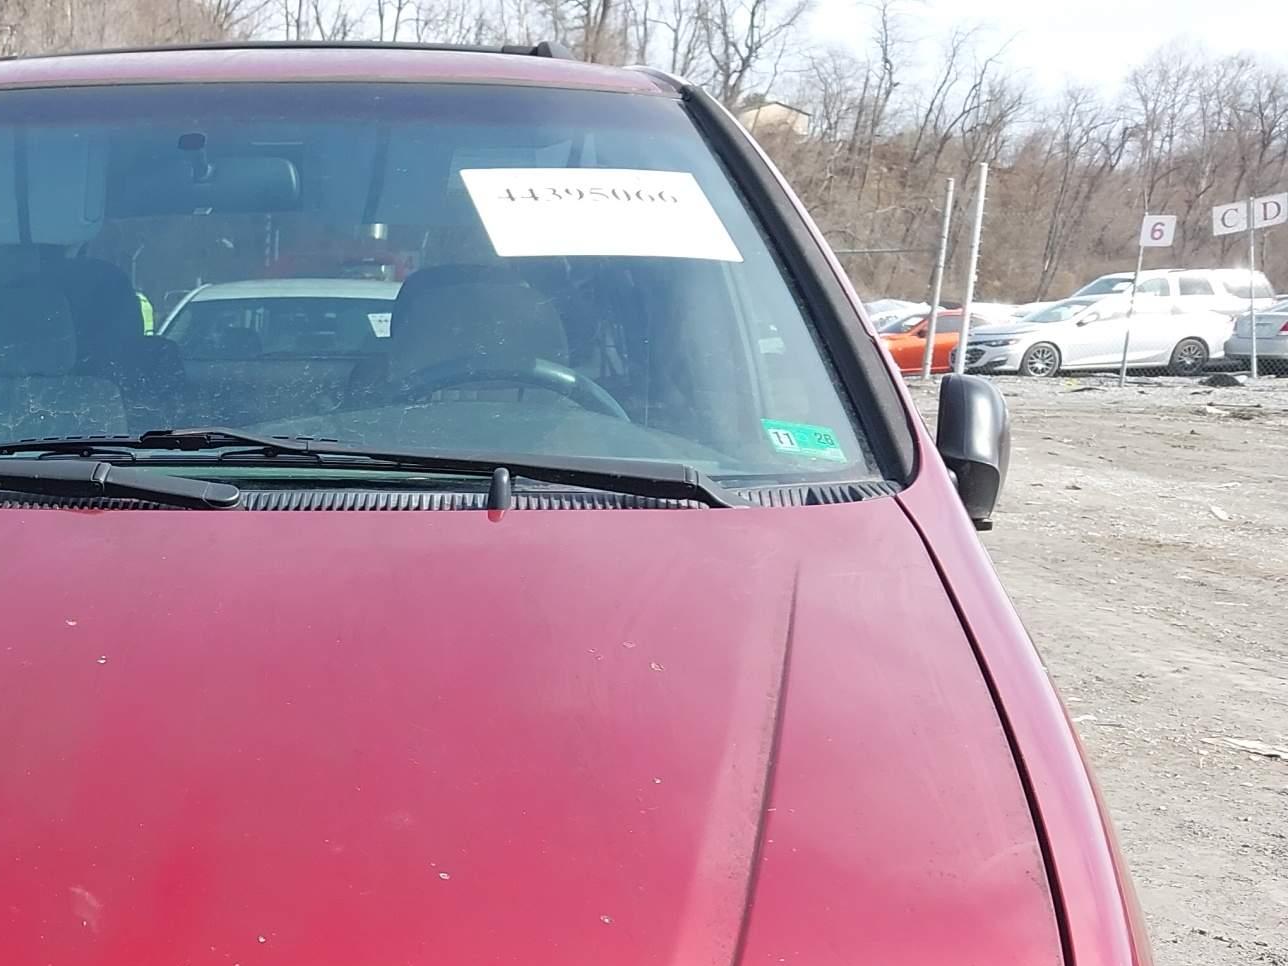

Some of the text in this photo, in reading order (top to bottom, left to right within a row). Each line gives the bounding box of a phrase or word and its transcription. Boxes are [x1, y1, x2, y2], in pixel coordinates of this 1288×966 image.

[497, 187, 679, 204] 44395066
[1220, 207, 1239, 229] C
[1262, 200, 1282, 222] D
[1149, 221, 1166, 241] 6
